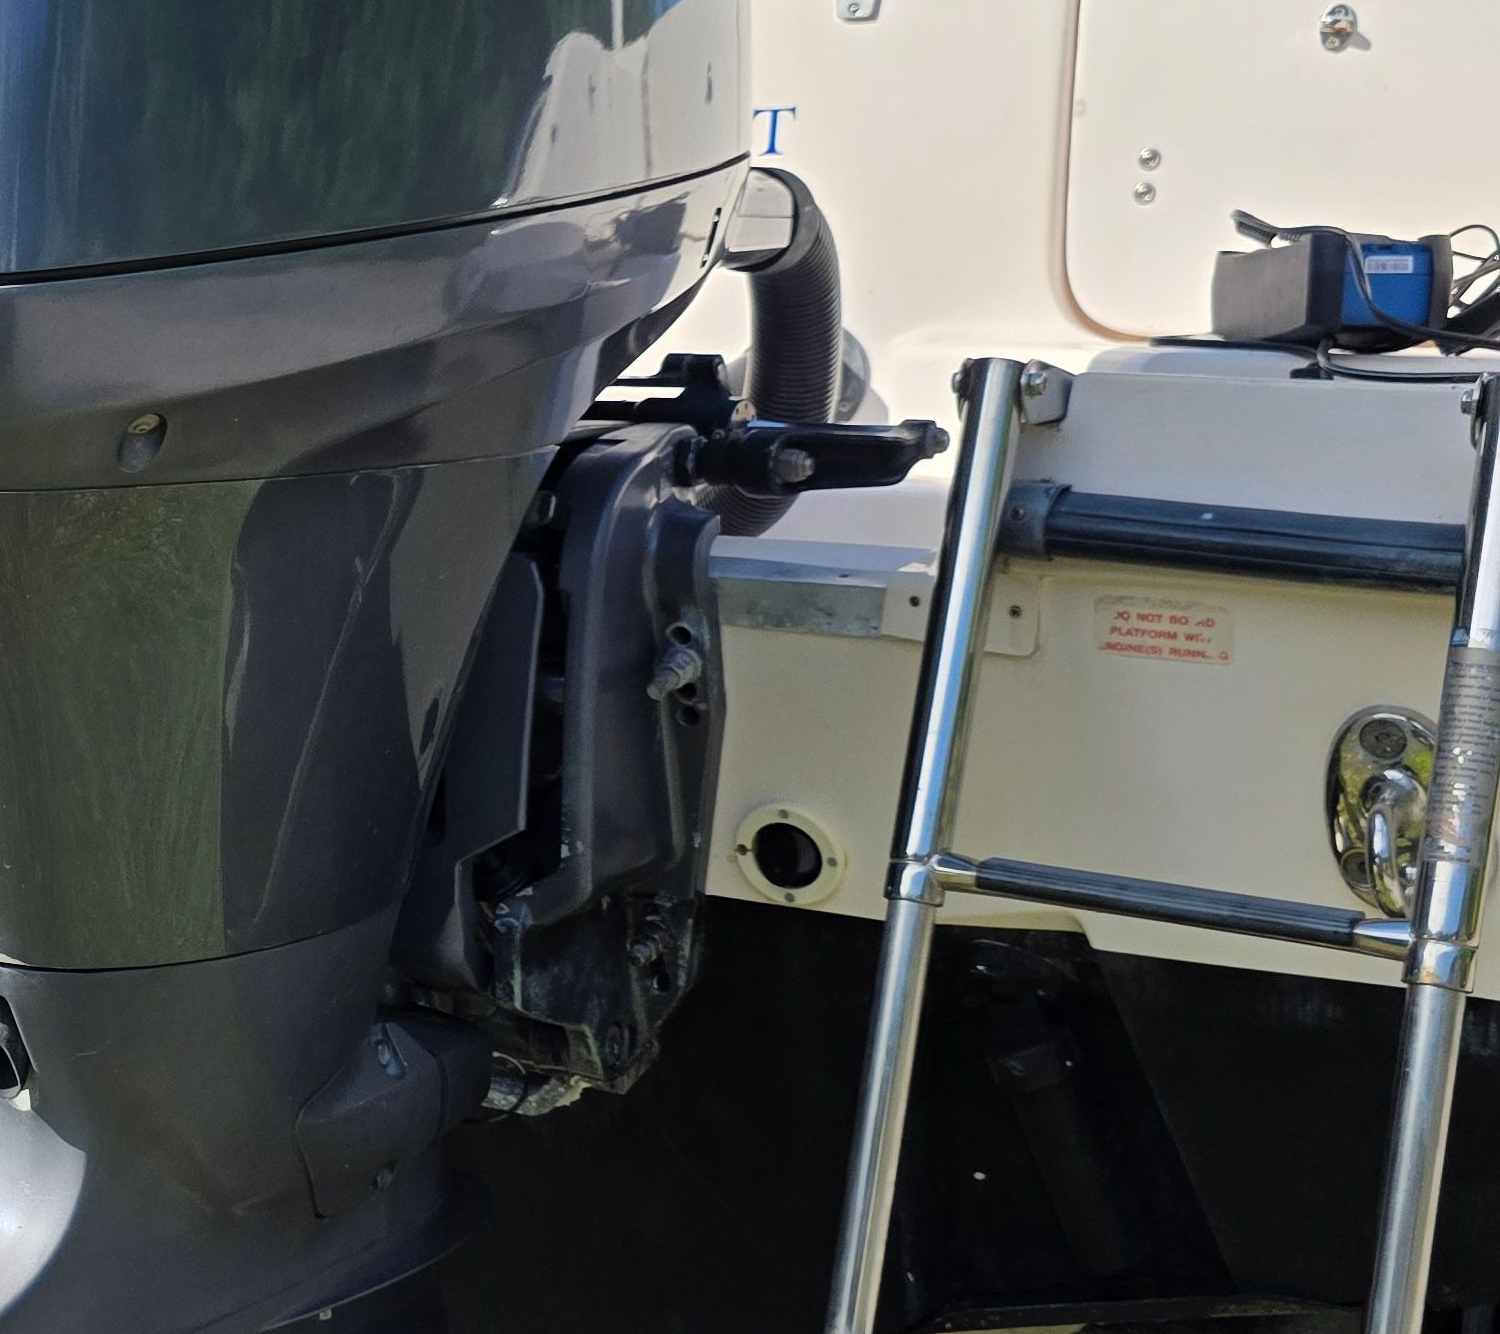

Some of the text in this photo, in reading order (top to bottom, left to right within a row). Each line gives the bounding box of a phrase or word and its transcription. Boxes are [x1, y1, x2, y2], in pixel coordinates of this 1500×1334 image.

[1136, 612, 1163, 624] NOT
[1110, 625, 1178, 641] PLATFORM
[1098, 641, 1162, 657] NGINE(S)
